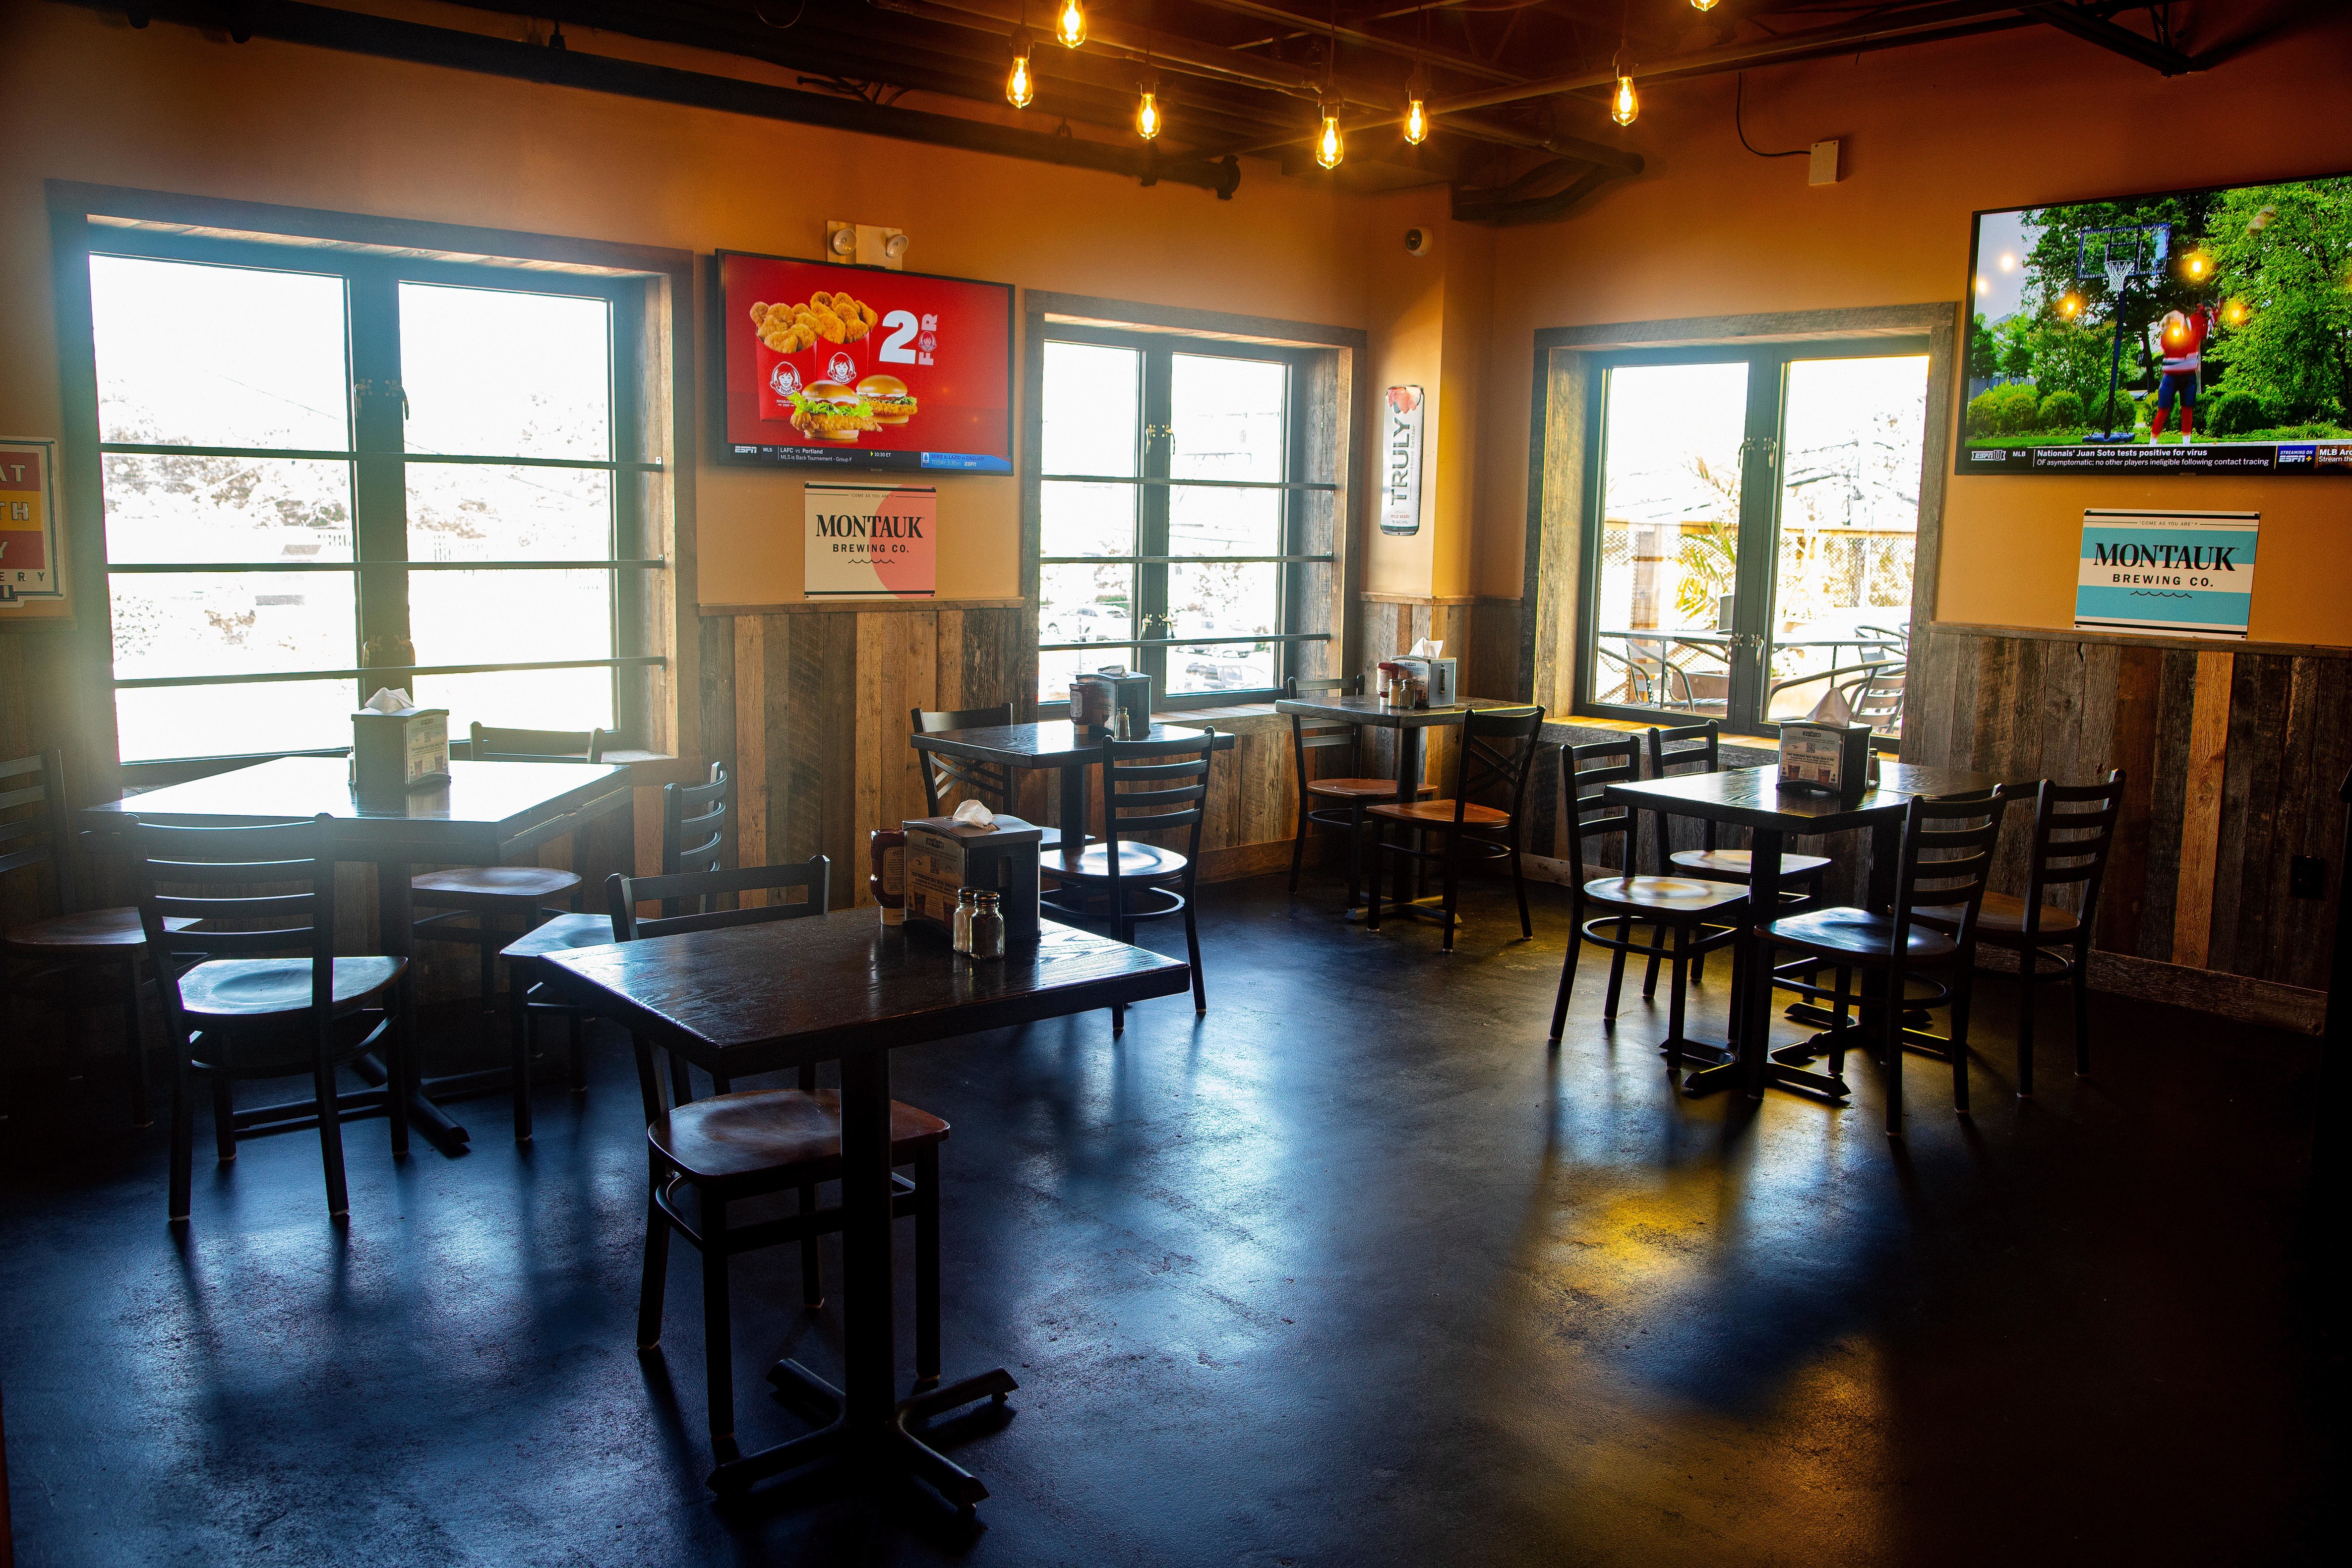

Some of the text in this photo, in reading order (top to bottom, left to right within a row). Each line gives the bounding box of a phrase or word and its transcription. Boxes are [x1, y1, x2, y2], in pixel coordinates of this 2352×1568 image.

[879, 310, 918, 364] 2
[1390, 417, 1410, 505] TRULY
[2139, 448, 2171, 457] positive
[2124, 458, 2149, 467] players
[2150, 458, 2180, 467] ineligible
[2181, 458, 2213, 466] following
[2243, 458, 2270, 466] tracing
[816, 515, 923, 538] MONTAUK
[833, 544, 909, 553] BREWING CO.
[2093, 543, 2235, 571] MONTAUK
[2112, 574, 2213, 587] BREWING CO.
